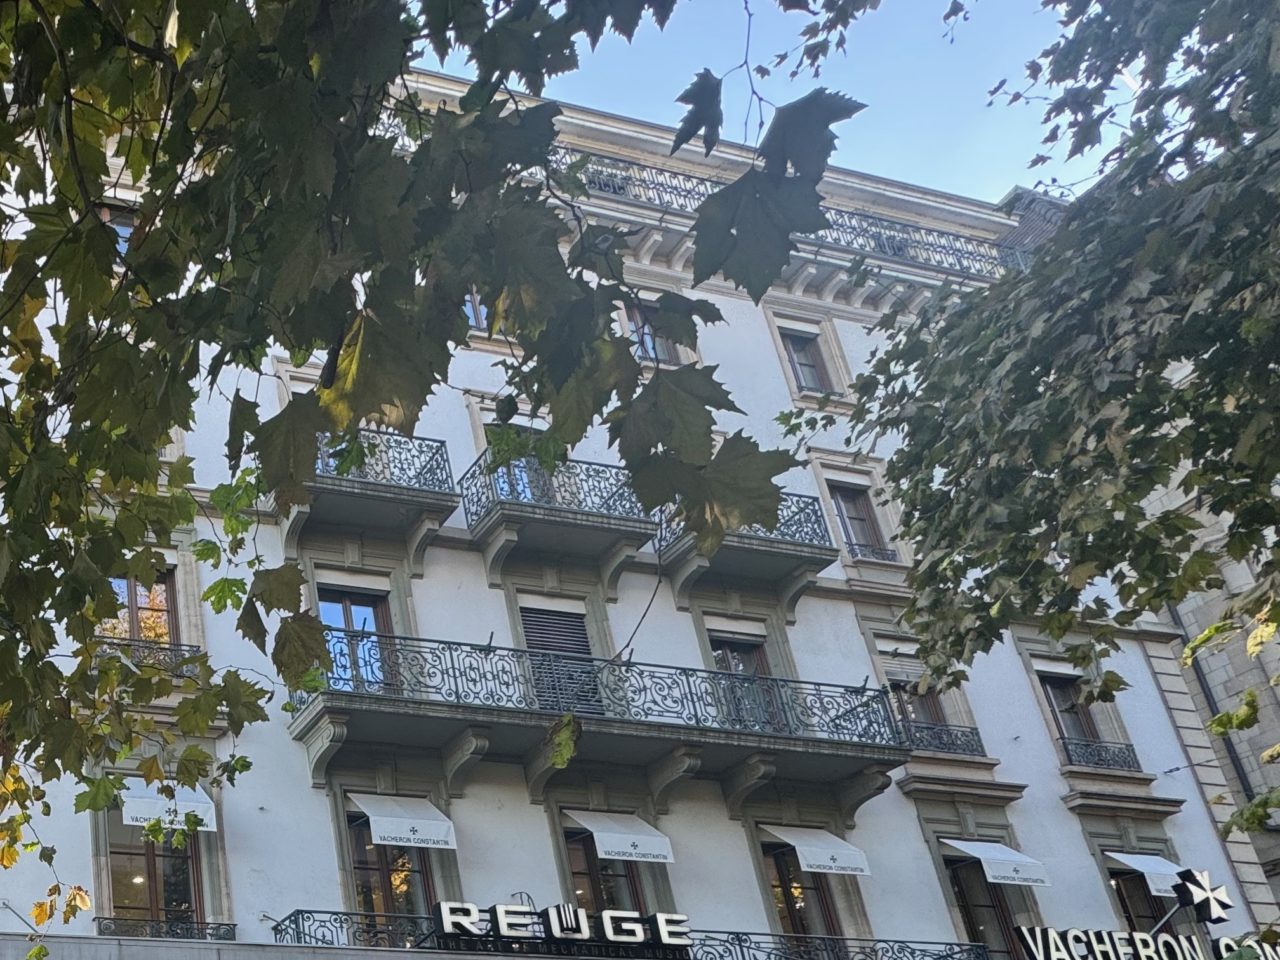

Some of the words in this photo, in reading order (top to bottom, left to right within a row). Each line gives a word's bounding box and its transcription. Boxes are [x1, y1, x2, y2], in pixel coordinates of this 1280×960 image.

[379, 835, 412, 844] VACHERON
[413, 837, 450, 846] CONSTANTIN
[604, 850, 634, 858] VACHERON
[635, 851, 668, 860] CONSTANTIN
[438, 901, 694, 945] REUGE
[538, 944, 634, 957] MECHANICAL
[646, 949, 690, 960] MUSIC
